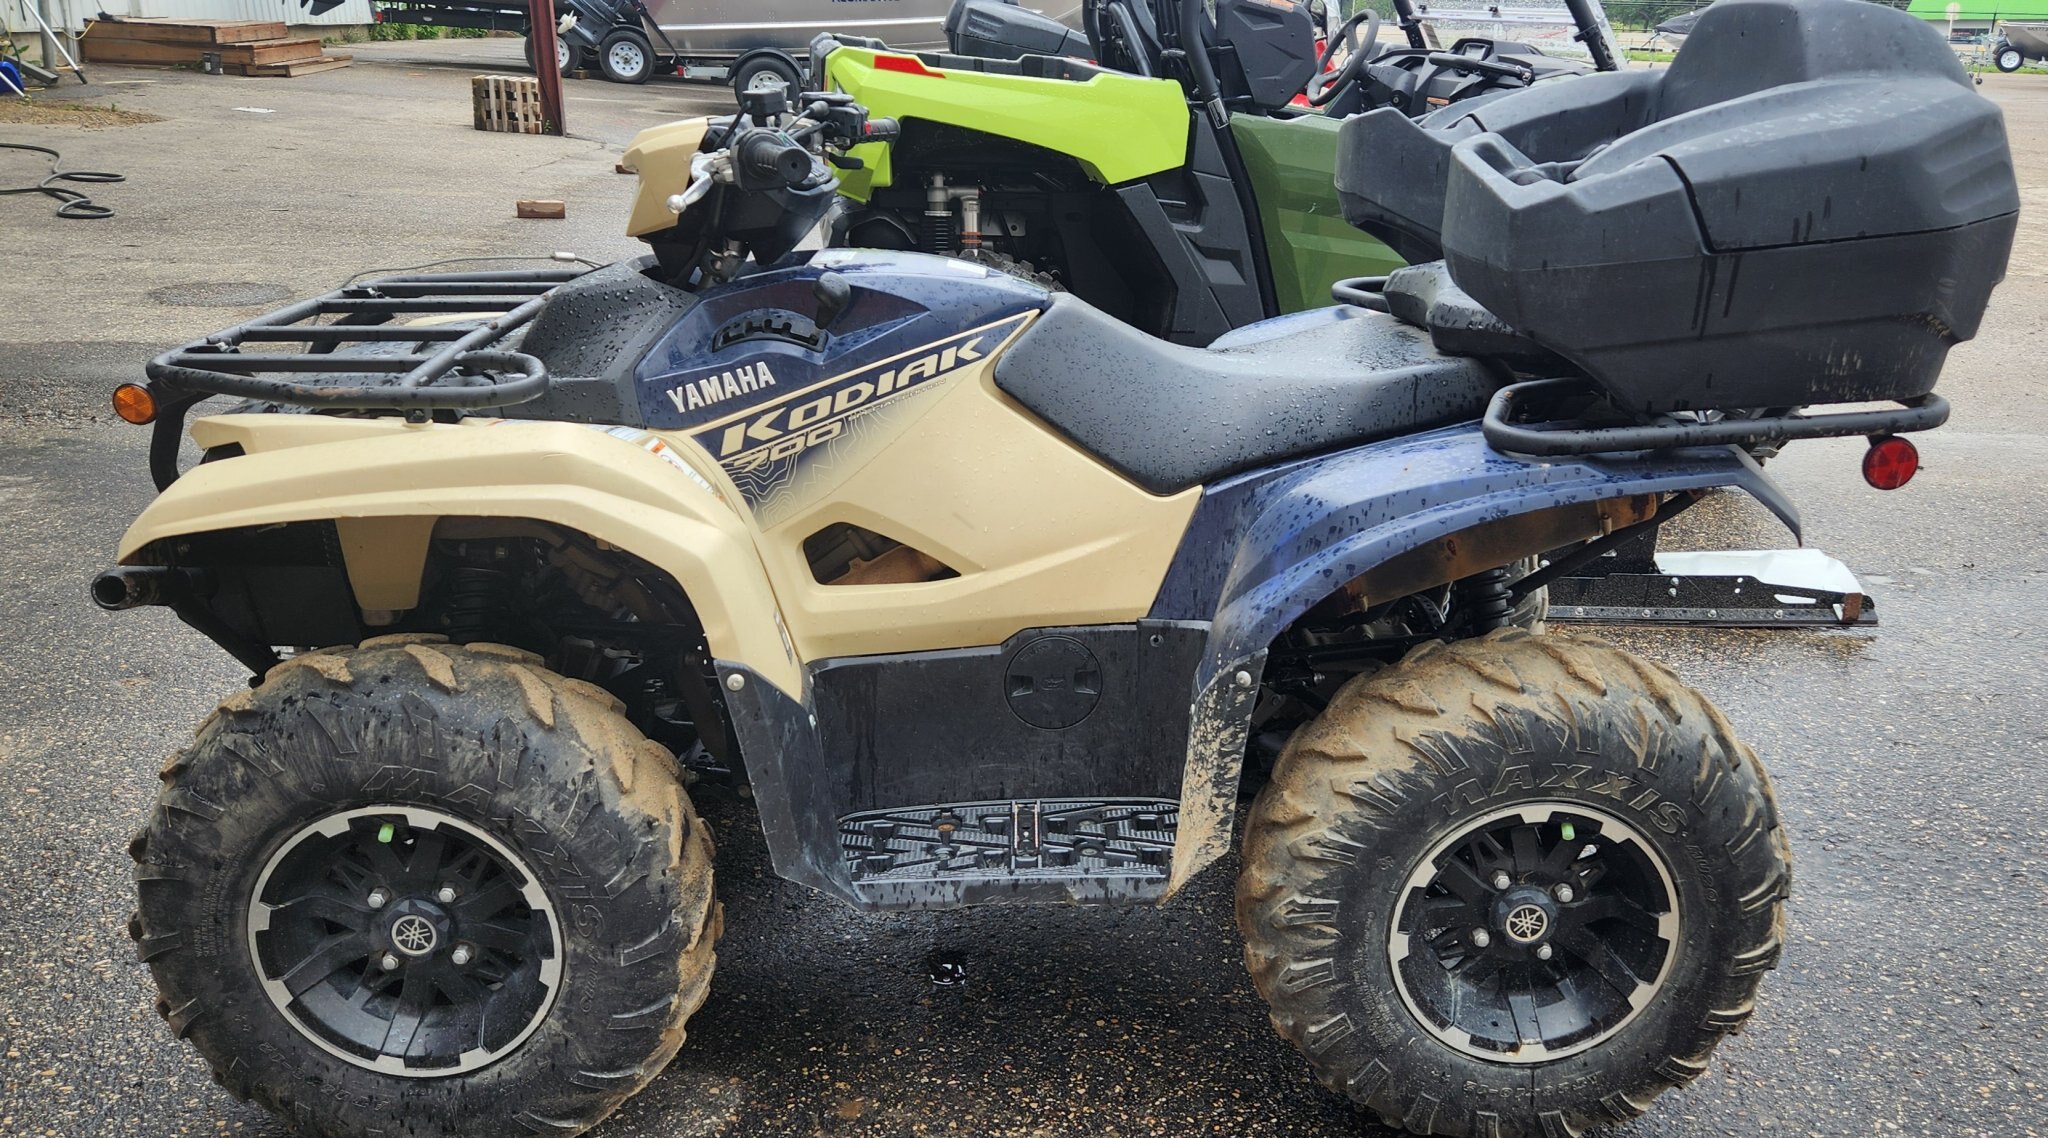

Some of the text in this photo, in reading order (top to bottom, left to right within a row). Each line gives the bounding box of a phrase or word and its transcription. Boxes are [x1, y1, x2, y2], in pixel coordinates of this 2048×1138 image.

[666, 360, 777, 414] YAMAHA
[720, 335, 984, 457] KODIAK
[732, 420, 843, 474] 700
[1426, 762, 1690, 836] MAXXIS
